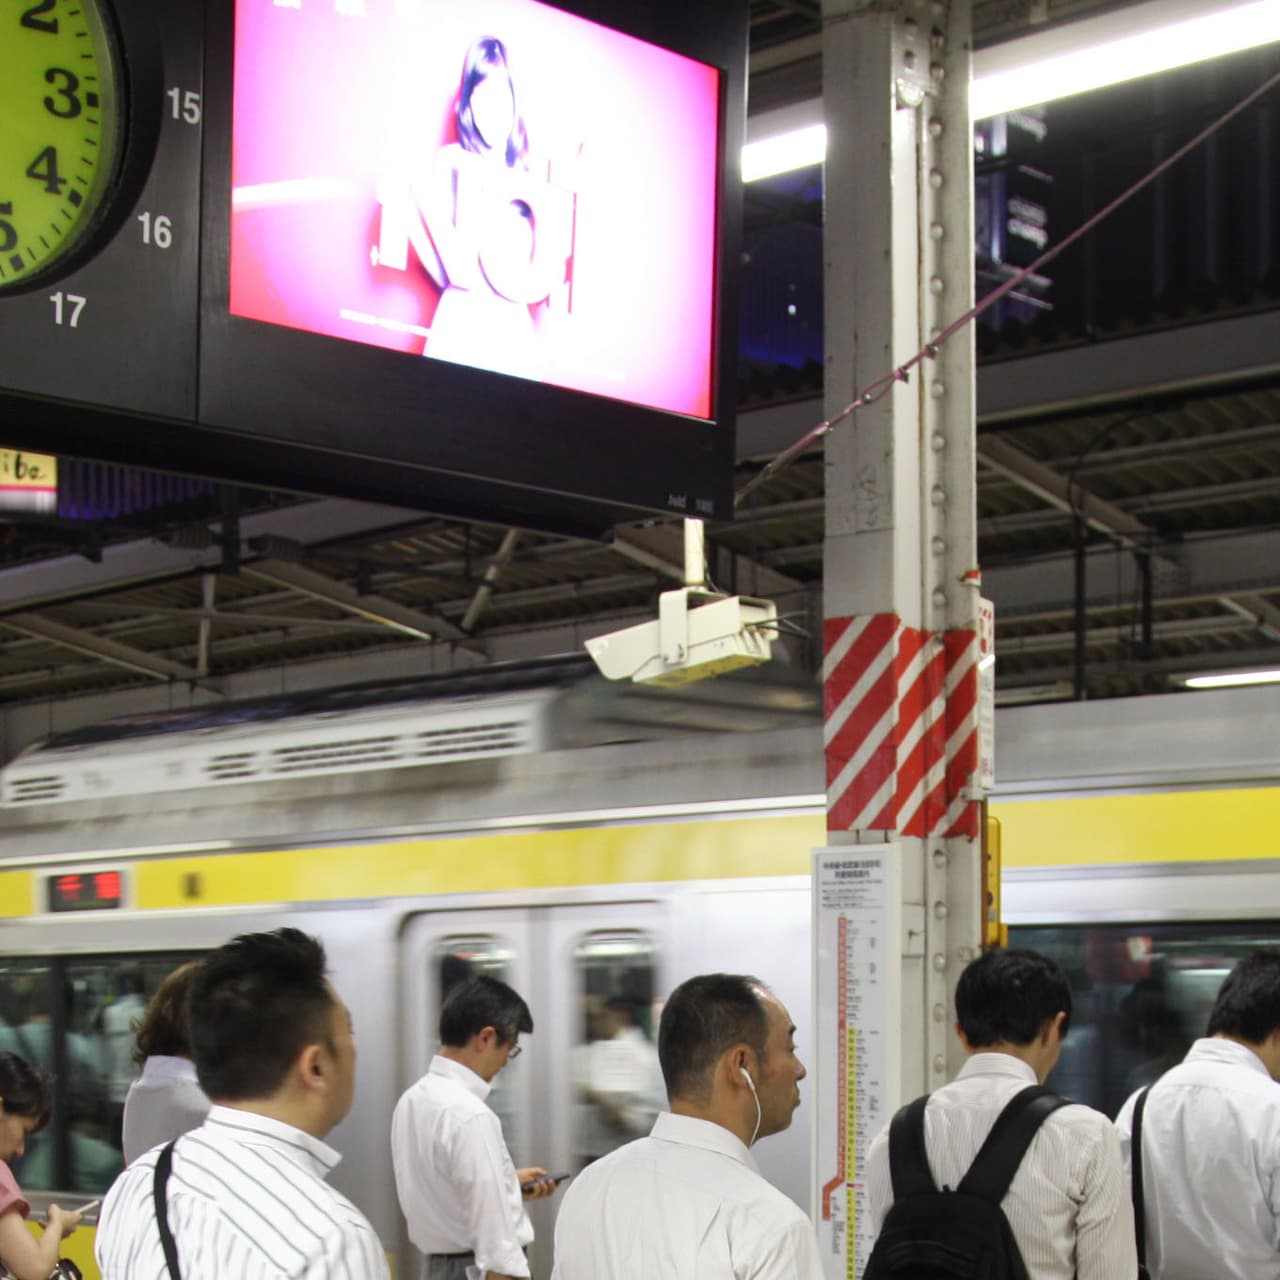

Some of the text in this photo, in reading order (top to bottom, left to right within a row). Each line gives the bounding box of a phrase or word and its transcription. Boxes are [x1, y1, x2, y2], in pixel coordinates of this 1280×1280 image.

[44, 68, 82, 119] 3
[167, 88, 201, 124] 15
[26, 145, 68, 195] 4
[138, 212, 173, 249] 16
[49, 291, 87, 328] 17
